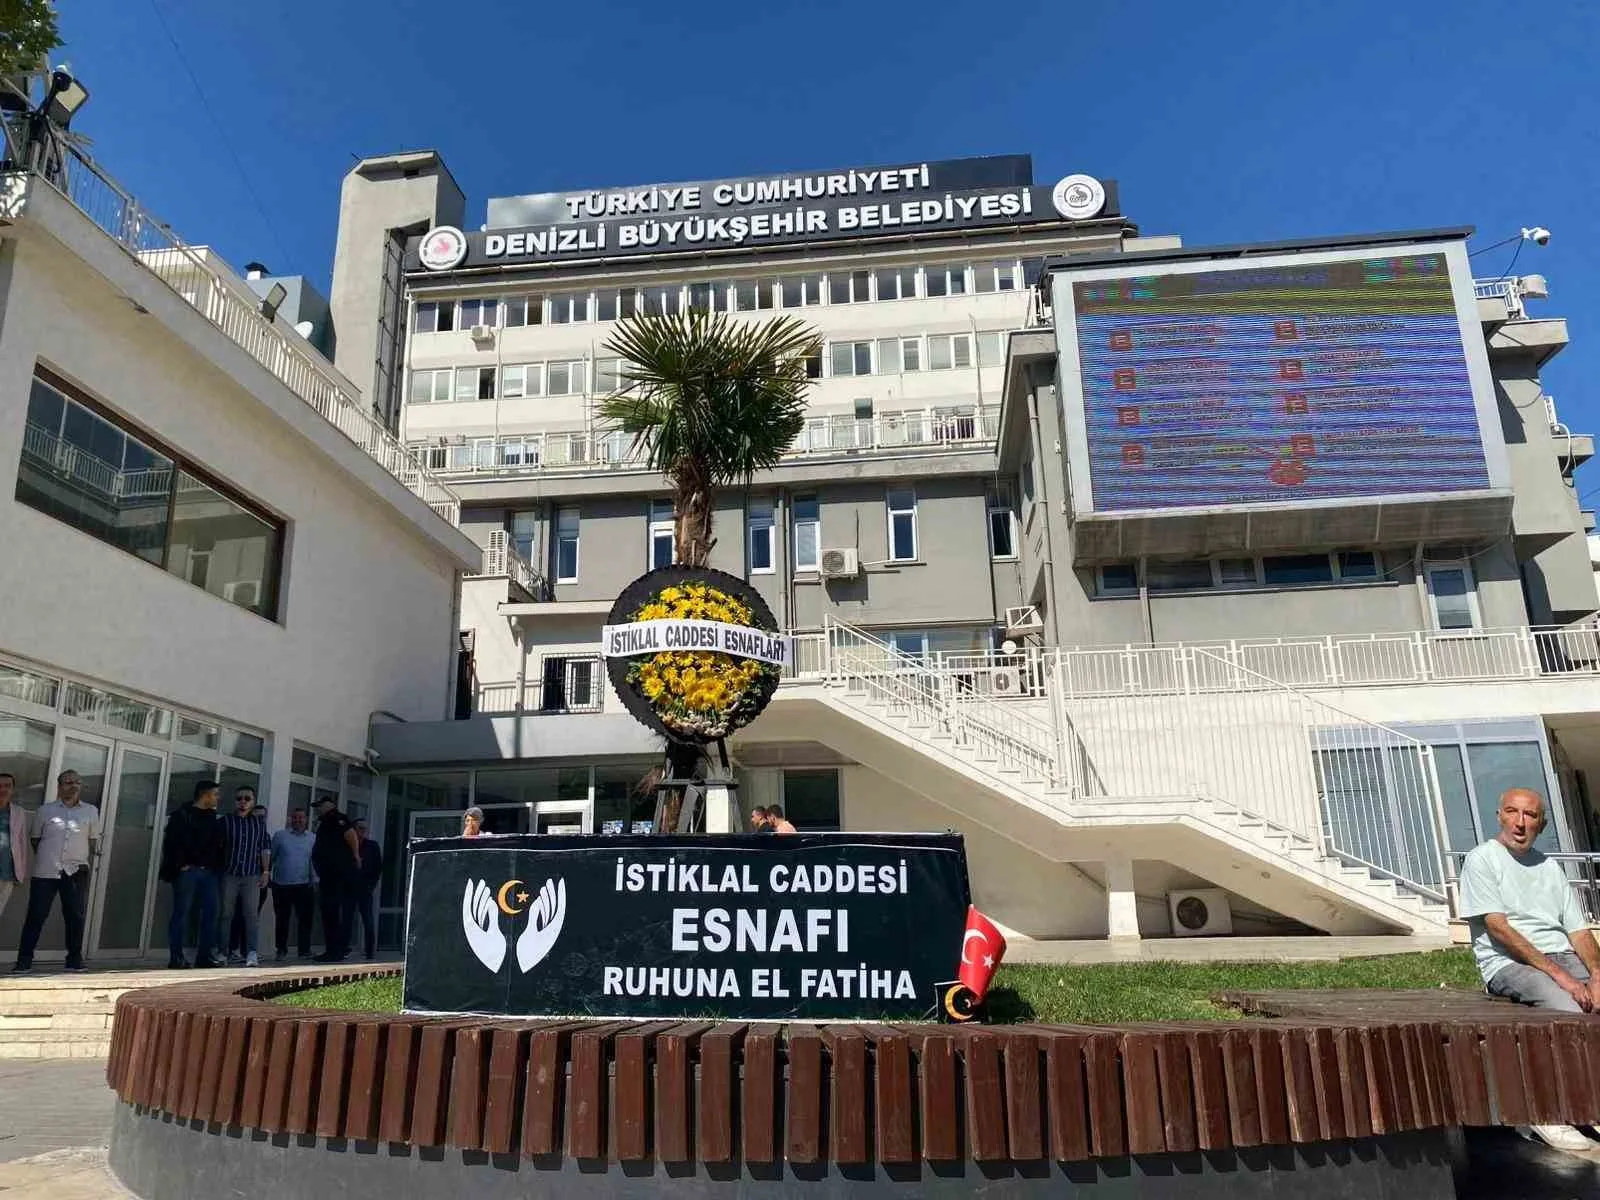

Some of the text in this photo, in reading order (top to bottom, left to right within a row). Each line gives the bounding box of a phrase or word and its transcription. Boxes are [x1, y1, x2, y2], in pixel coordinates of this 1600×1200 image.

[566, 163, 929, 217] TÜRKİYE CUMHURİYETİ
[485, 223, 606, 256] DENİZLİ
[619, 207, 828, 248] BÜYÜKŞEHİR
[838, 187, 1032, 229] BELEDİYESİ
[610, 623, 785, 662] İSTİKLAL CADDESİ ESNAFLARI
[615, 857, 908, 895] İSTİKLAL CADDESİ
[671, 908, 849, 953] ESNAFI
[603, 962, 917, 999] RUHUNA EL FATİHA
